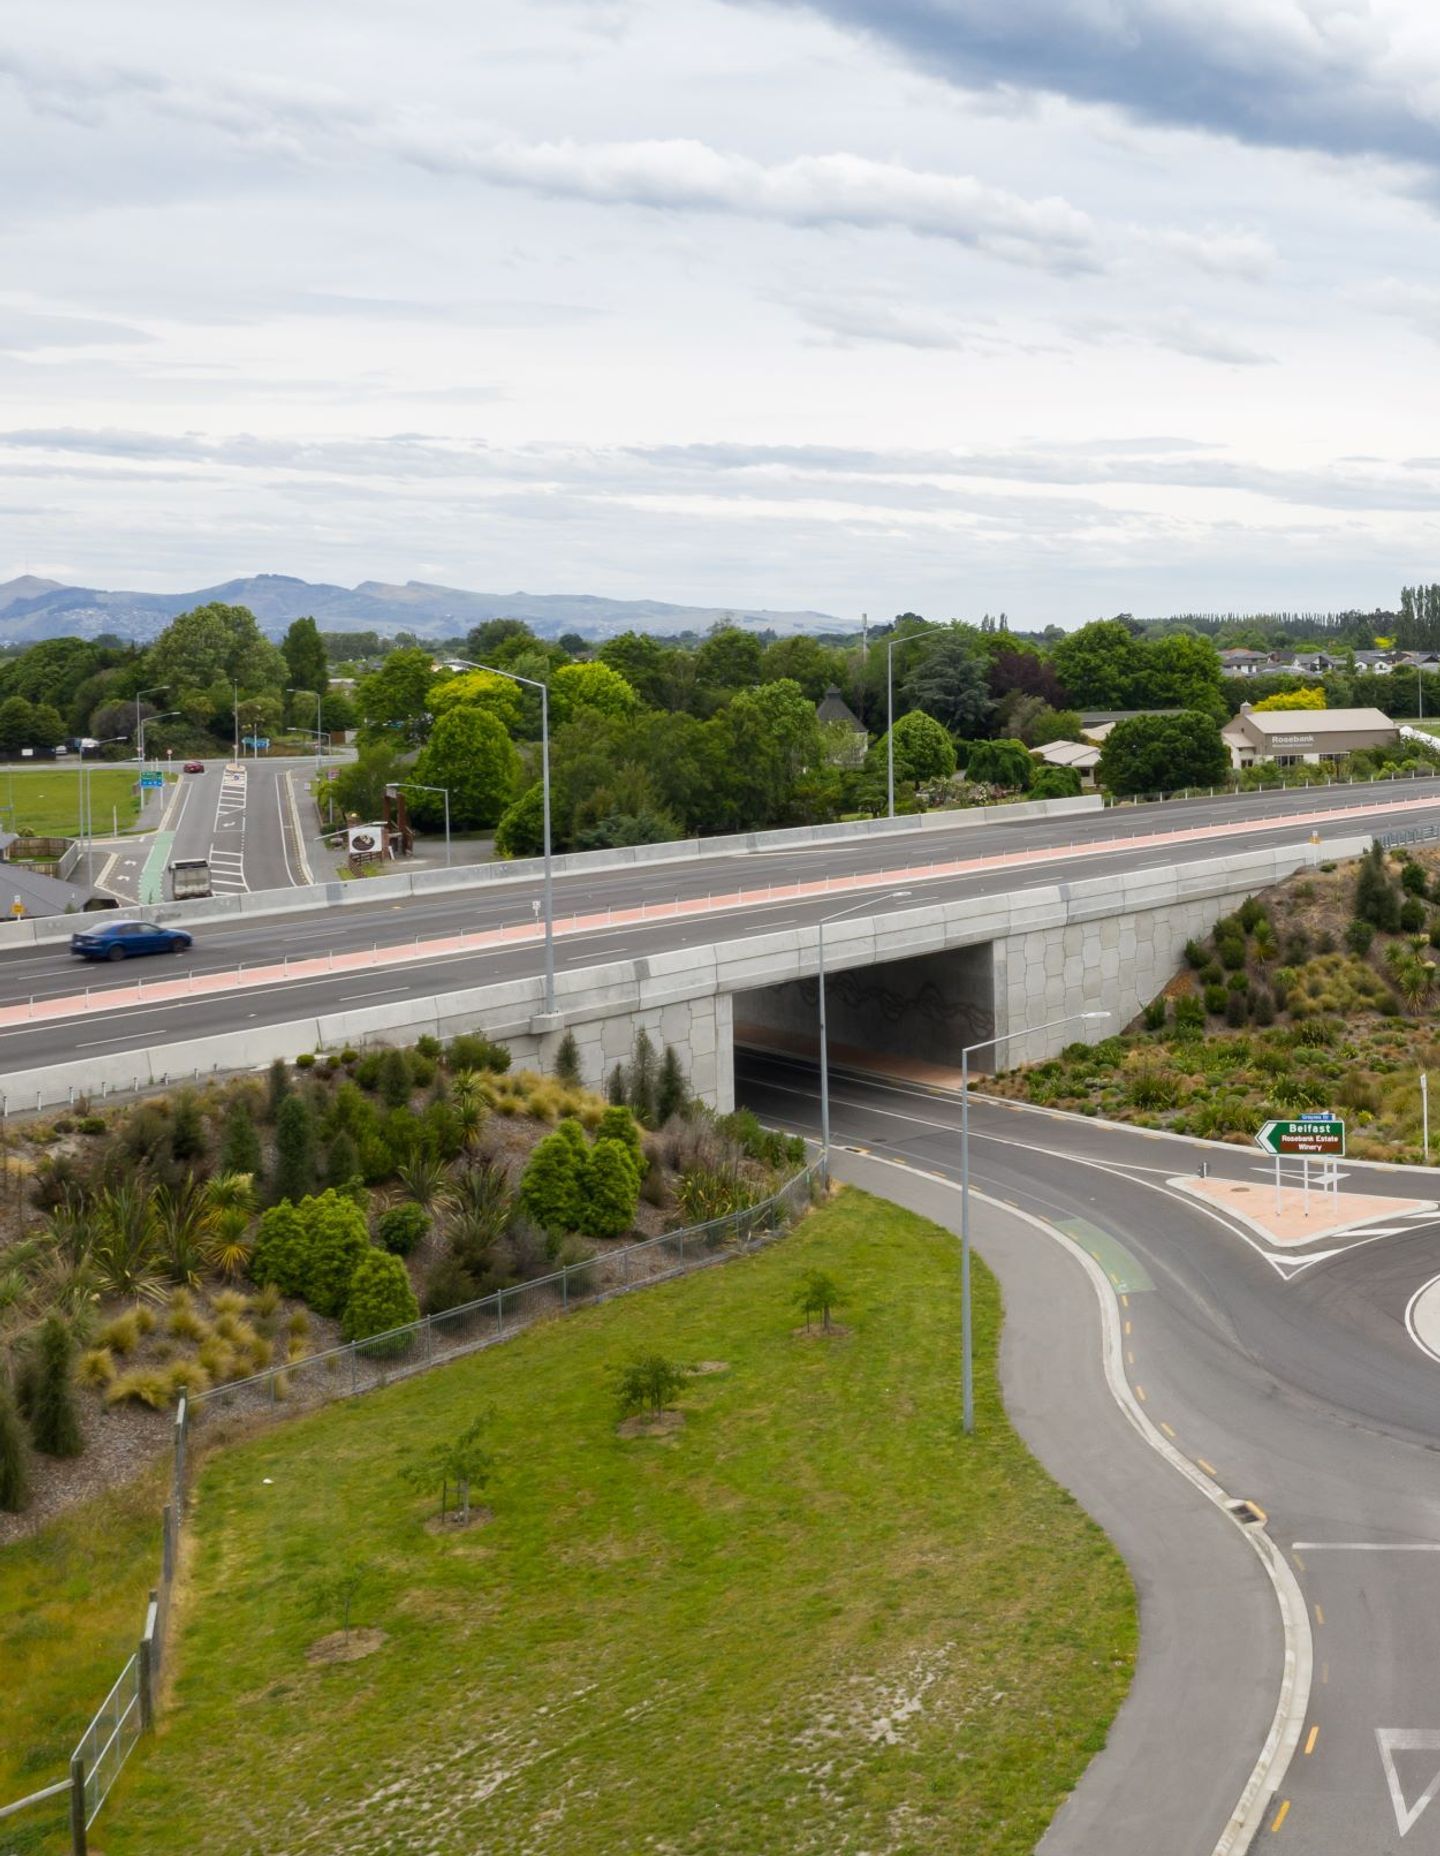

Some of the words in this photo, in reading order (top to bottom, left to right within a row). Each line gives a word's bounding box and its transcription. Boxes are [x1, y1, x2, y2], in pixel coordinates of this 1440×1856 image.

[1271, 735, 1314, 743] Rosebank
[1289, 1124, 1331, 1133] Belfast
[1298, 1143, 1322, 1152] Winery
